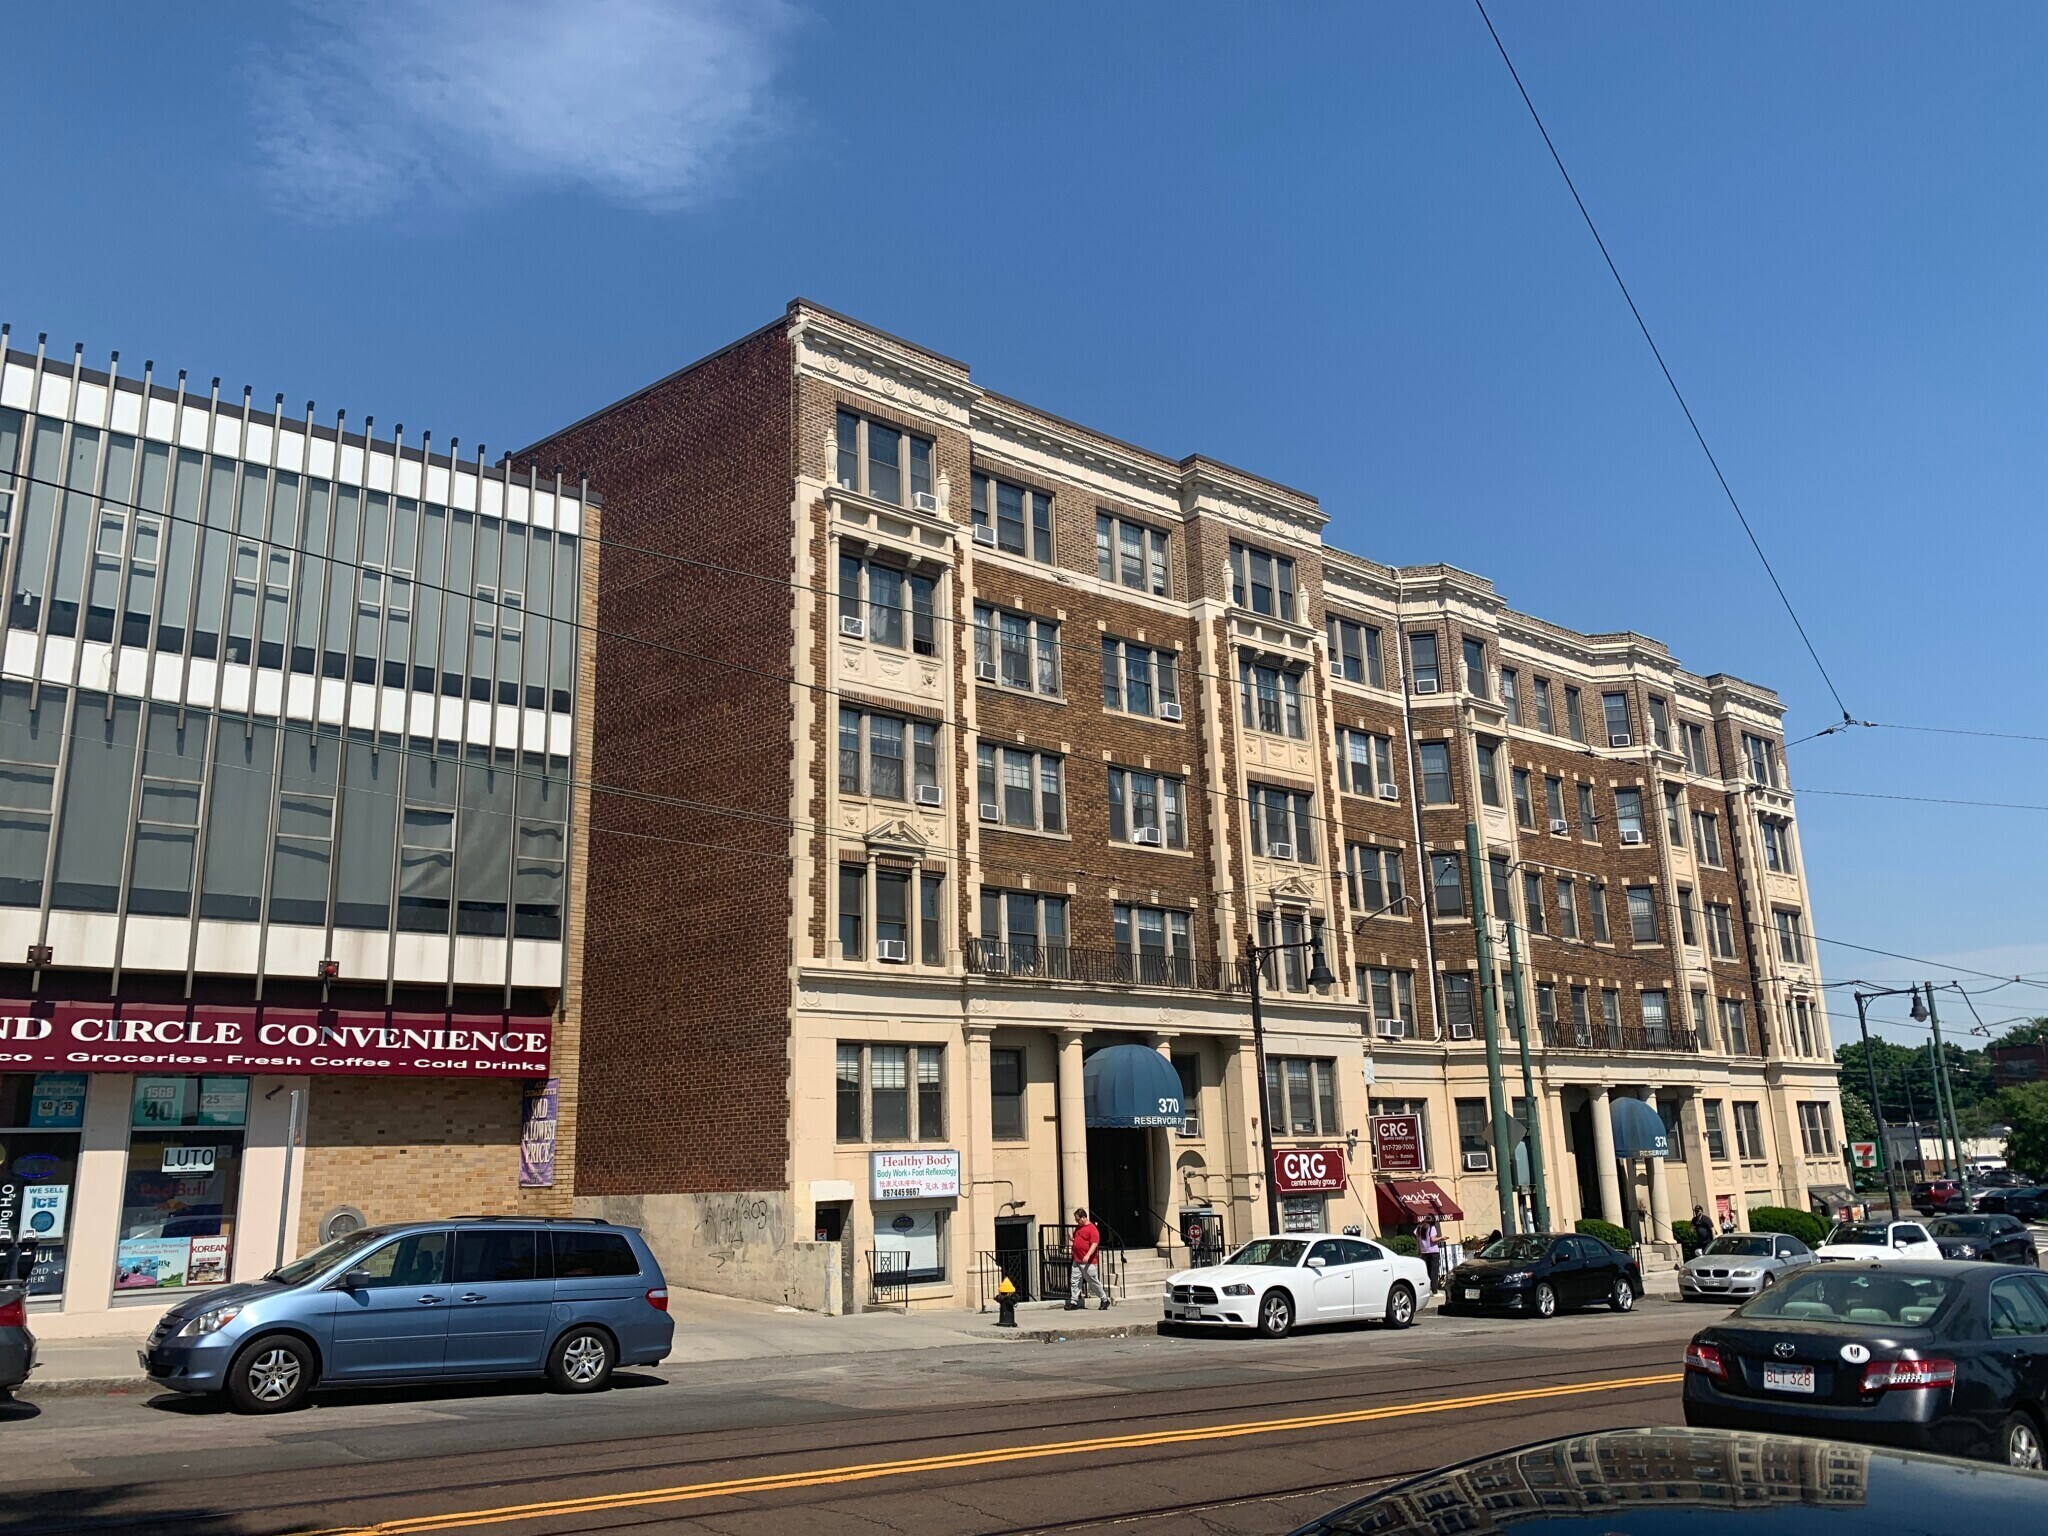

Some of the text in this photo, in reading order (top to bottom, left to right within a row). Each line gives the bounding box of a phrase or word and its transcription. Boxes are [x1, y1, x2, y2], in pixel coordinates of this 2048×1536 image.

[71, 1018, 243, 1044] CIRCLE
[258, 1024, 548, 1053] CONVENIENCE
[66, 1052, 208, 1064] Groceries
[227, 1055, 301, 1066] Fresh
[310, 1057, 391, 1067] Coffee
[414, 1059, 468, 1069] Cold
[475, 1060, 547, 1071] Drinks
[146, 1087, 175, 1098] 15GB
[142, 1101, 173, 1121] $40
[532, 1098, 548, 1119] SOLD
[1158, 1098, 1179, 1113] 370
[1134, 1116, 1177, 1125] RESERVOIR
[530, 1120, 556, 1141] LOWEST
[1379, 1122, 1408, 1137] CRG
[526, 1142, 551, 1164] PRICE
[882, 1154, 952, 1168] Healthy Body
[1284, 1153, 1326, 1179] CRG
[877, 1169, 892, 1179] Body
[893, 1168, 908, 1177] Work
[911, 1168, 925, 1177] Foot
[925, 1167, 957, 1177] Reflexology
[176, 1181, 207, 1196] Bull
[1308, 1179, 1321, 1187] realty
[1322, 1179, 1337, 1188] group
[31, 1195, 58, 1209] ICE
[192, 1244, 228, 1254] KOREAN
[31, 1267, 49, 1275] OLD
[1790, 1371, 1811, 1386] 328
